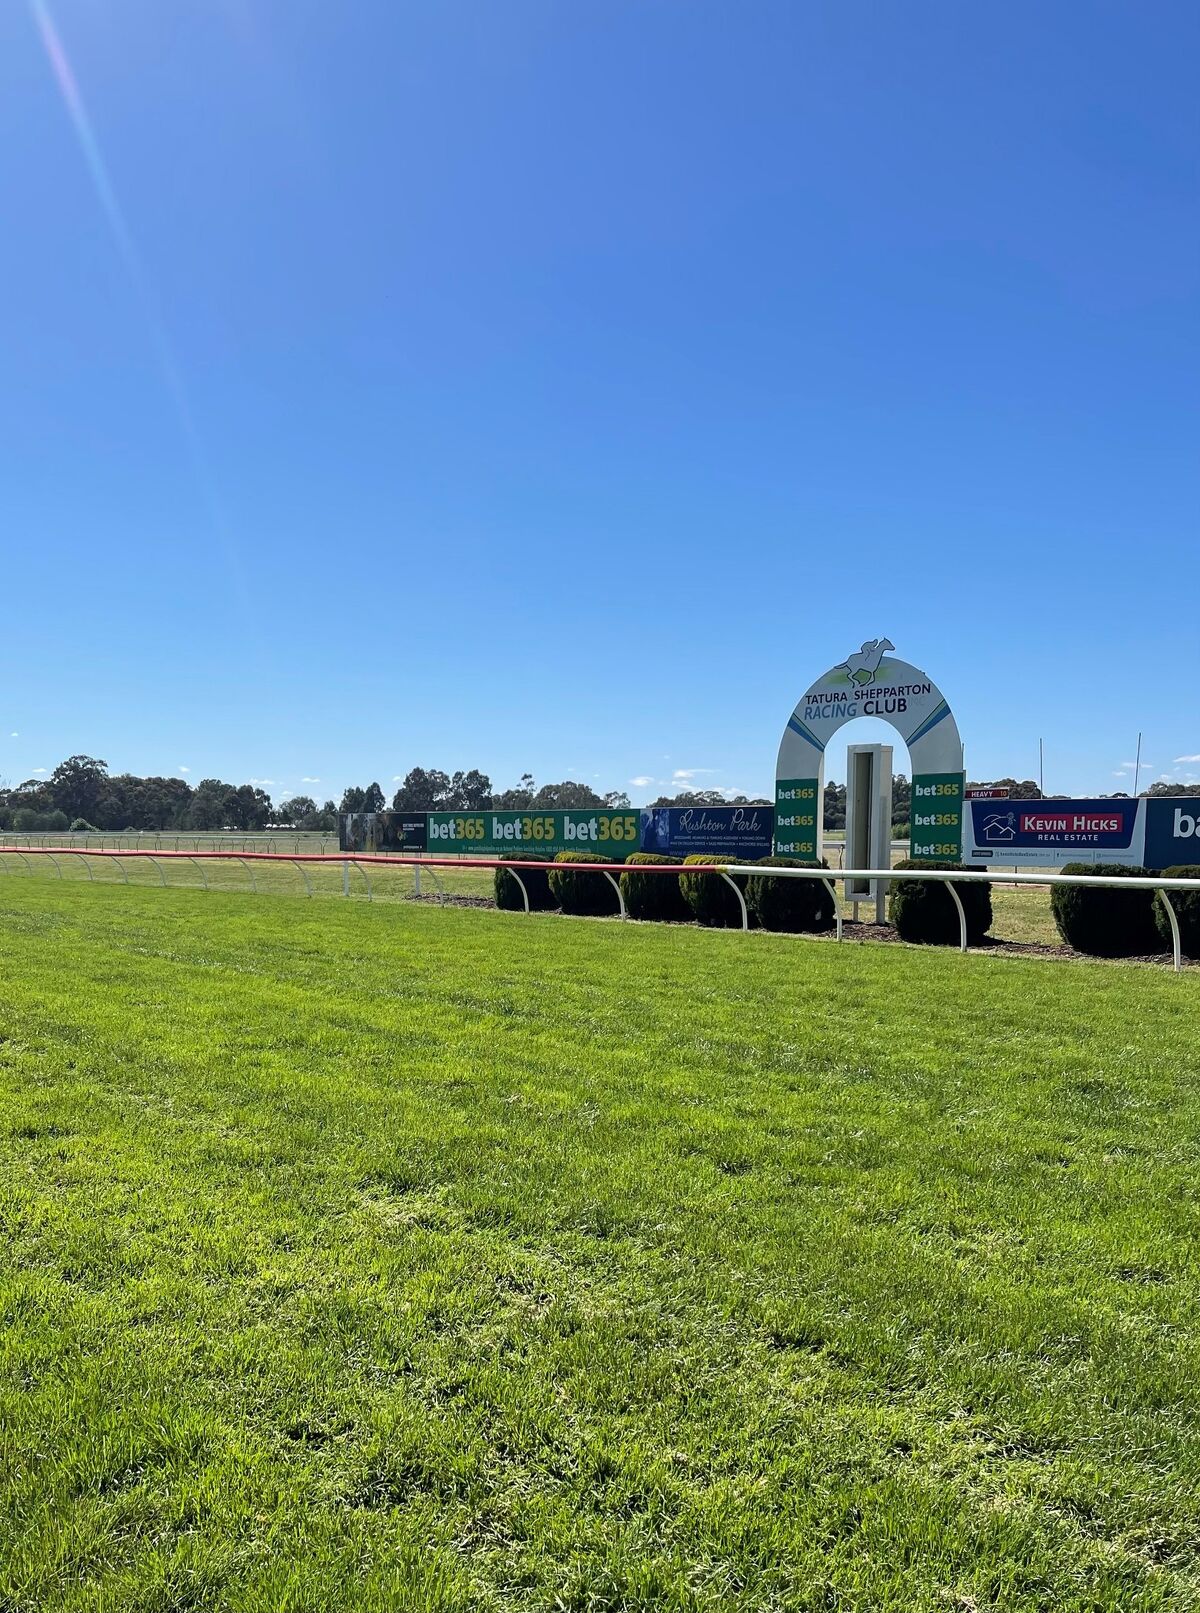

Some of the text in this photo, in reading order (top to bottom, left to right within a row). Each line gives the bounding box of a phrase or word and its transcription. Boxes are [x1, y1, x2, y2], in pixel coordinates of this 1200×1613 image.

[805, 683, 931, 705] TATURA SHEPPARTON
[804, 702, 857, 720] RACING
[863, 698, 907, 715] CLUB
[778, 789, 814, 800] bet365
[915, 784, 959, 796] bet365
[680, 808, 762, 833] Rushton Park
[777, 815, 813, 826] bet365
[914, 813, 958, 826] bet365
[1024, 816, 1118, 831] KEVIN HICKS
[1173, 808, 1200, 838] b
[429, 816, 637, 841] bet365 bet365 bet365
[777, 842, 813, 853] bet365
[914, 843, 957, 855] bet365
